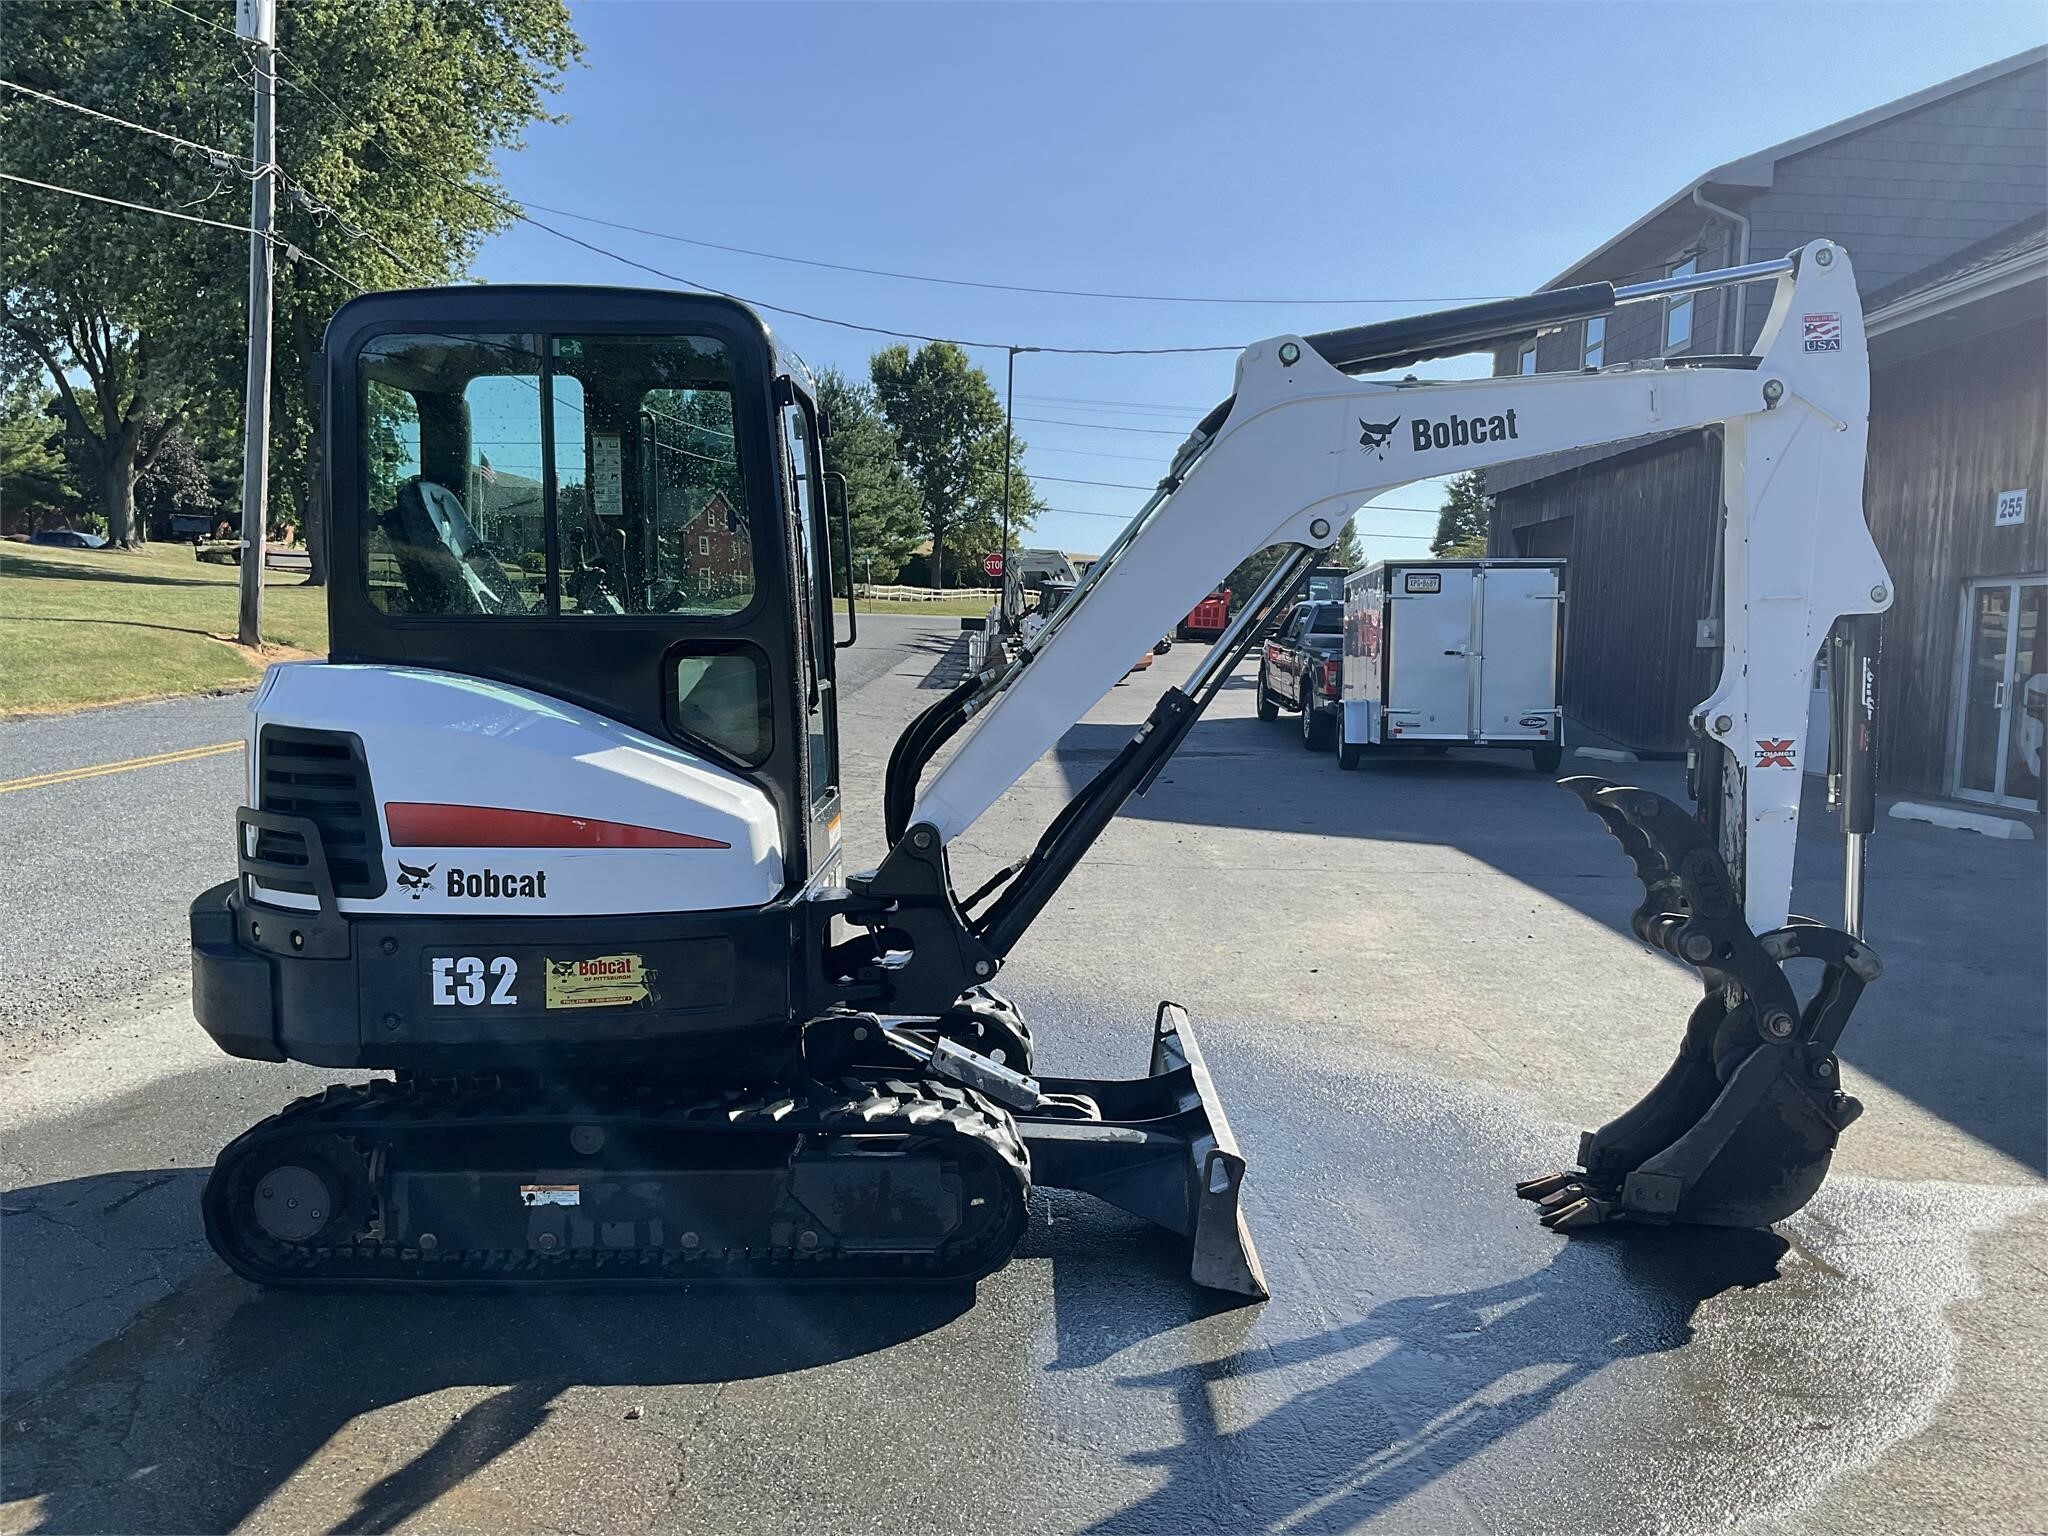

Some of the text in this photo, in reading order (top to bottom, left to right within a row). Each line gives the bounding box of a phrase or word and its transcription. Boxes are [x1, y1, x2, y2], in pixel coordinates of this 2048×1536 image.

[1806, 340, 1839, 351] USA
[1411, 408, 1519, 452] Bobcat
[1999, 496, 2023, 519] 255
[447, 868, 547, 899] Bobcat
[579, 958, 632, 976] Bobcat
[593, 974, 632, 982] PITTSBURGH
[431, 956, 518, 1006] E32
